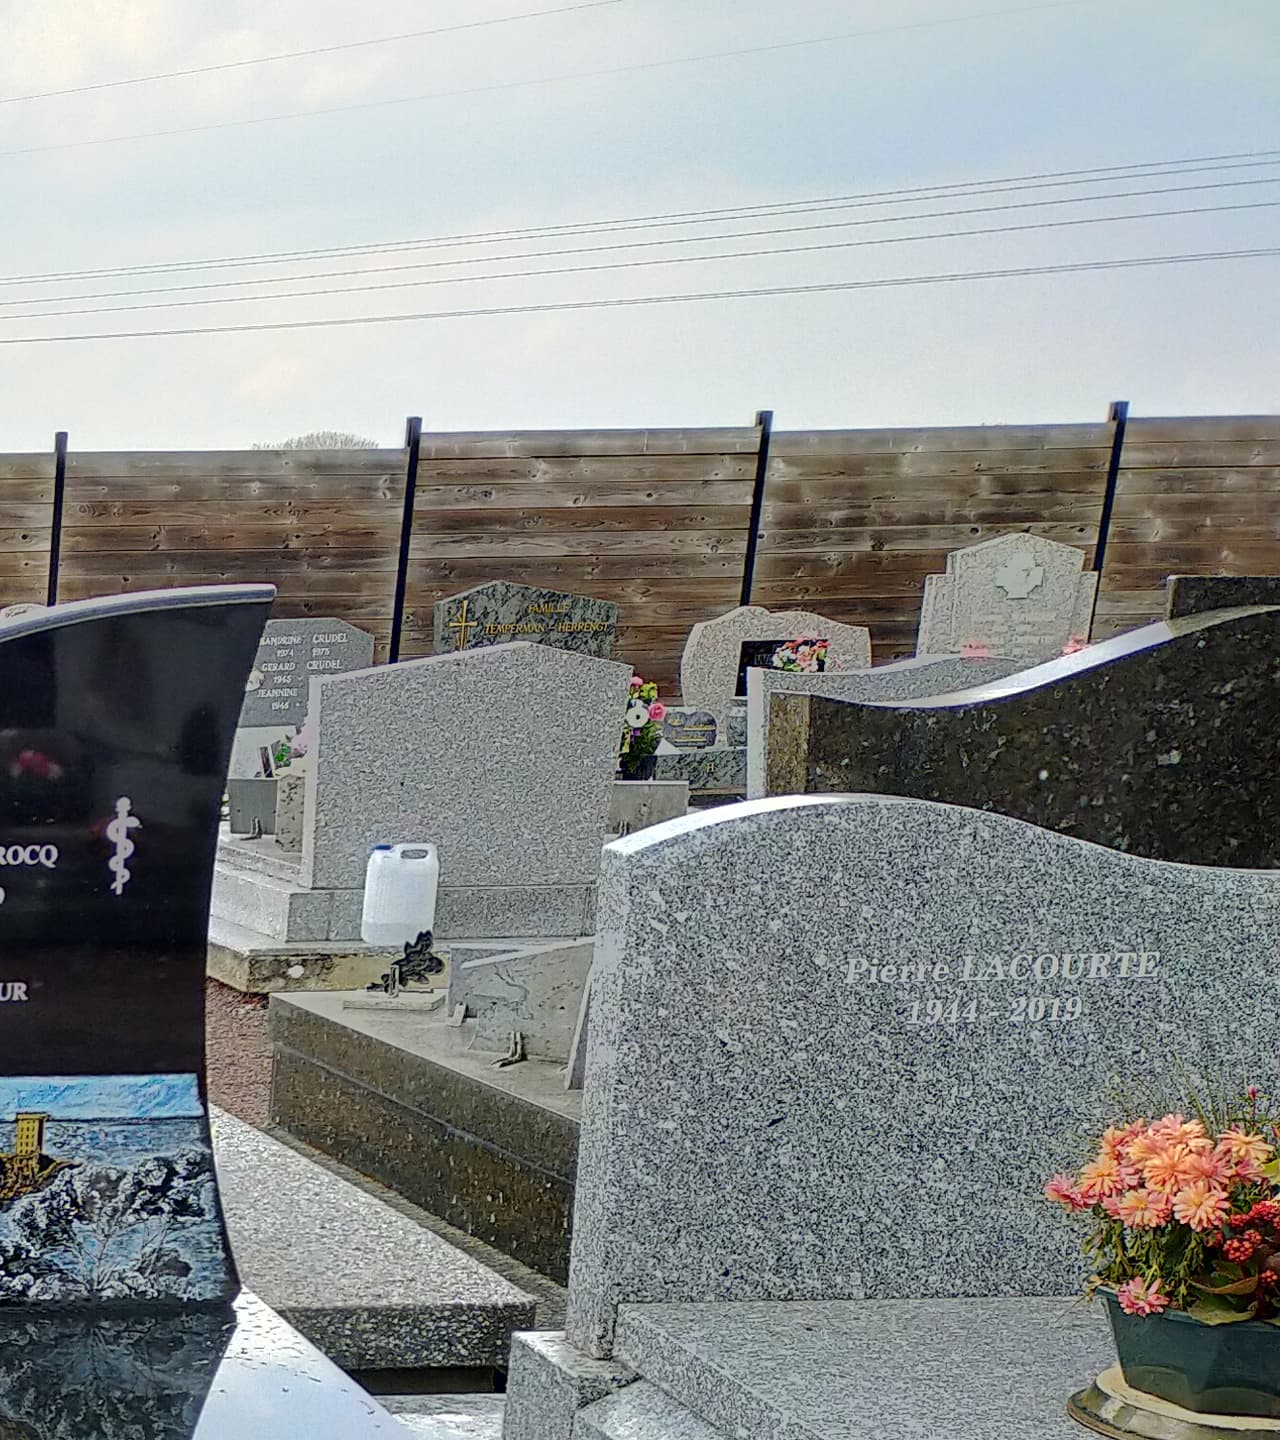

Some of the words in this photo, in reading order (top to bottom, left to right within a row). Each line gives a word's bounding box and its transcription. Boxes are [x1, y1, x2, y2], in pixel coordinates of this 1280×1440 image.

[528, 602, 570, 614] FAMILLE
[484, 622, 545, 635] TEMPERMAN
[312, 632, 349, 644] CRUDEL
[262, 661, 296, 672] GERARD
[306, 660, 342, 670] CRUDEL
[843, 956, 950, 984] Pierre
[960, 951, 1160, 982] LACOURTE
[906, 1000, 980, 1025] 1944
